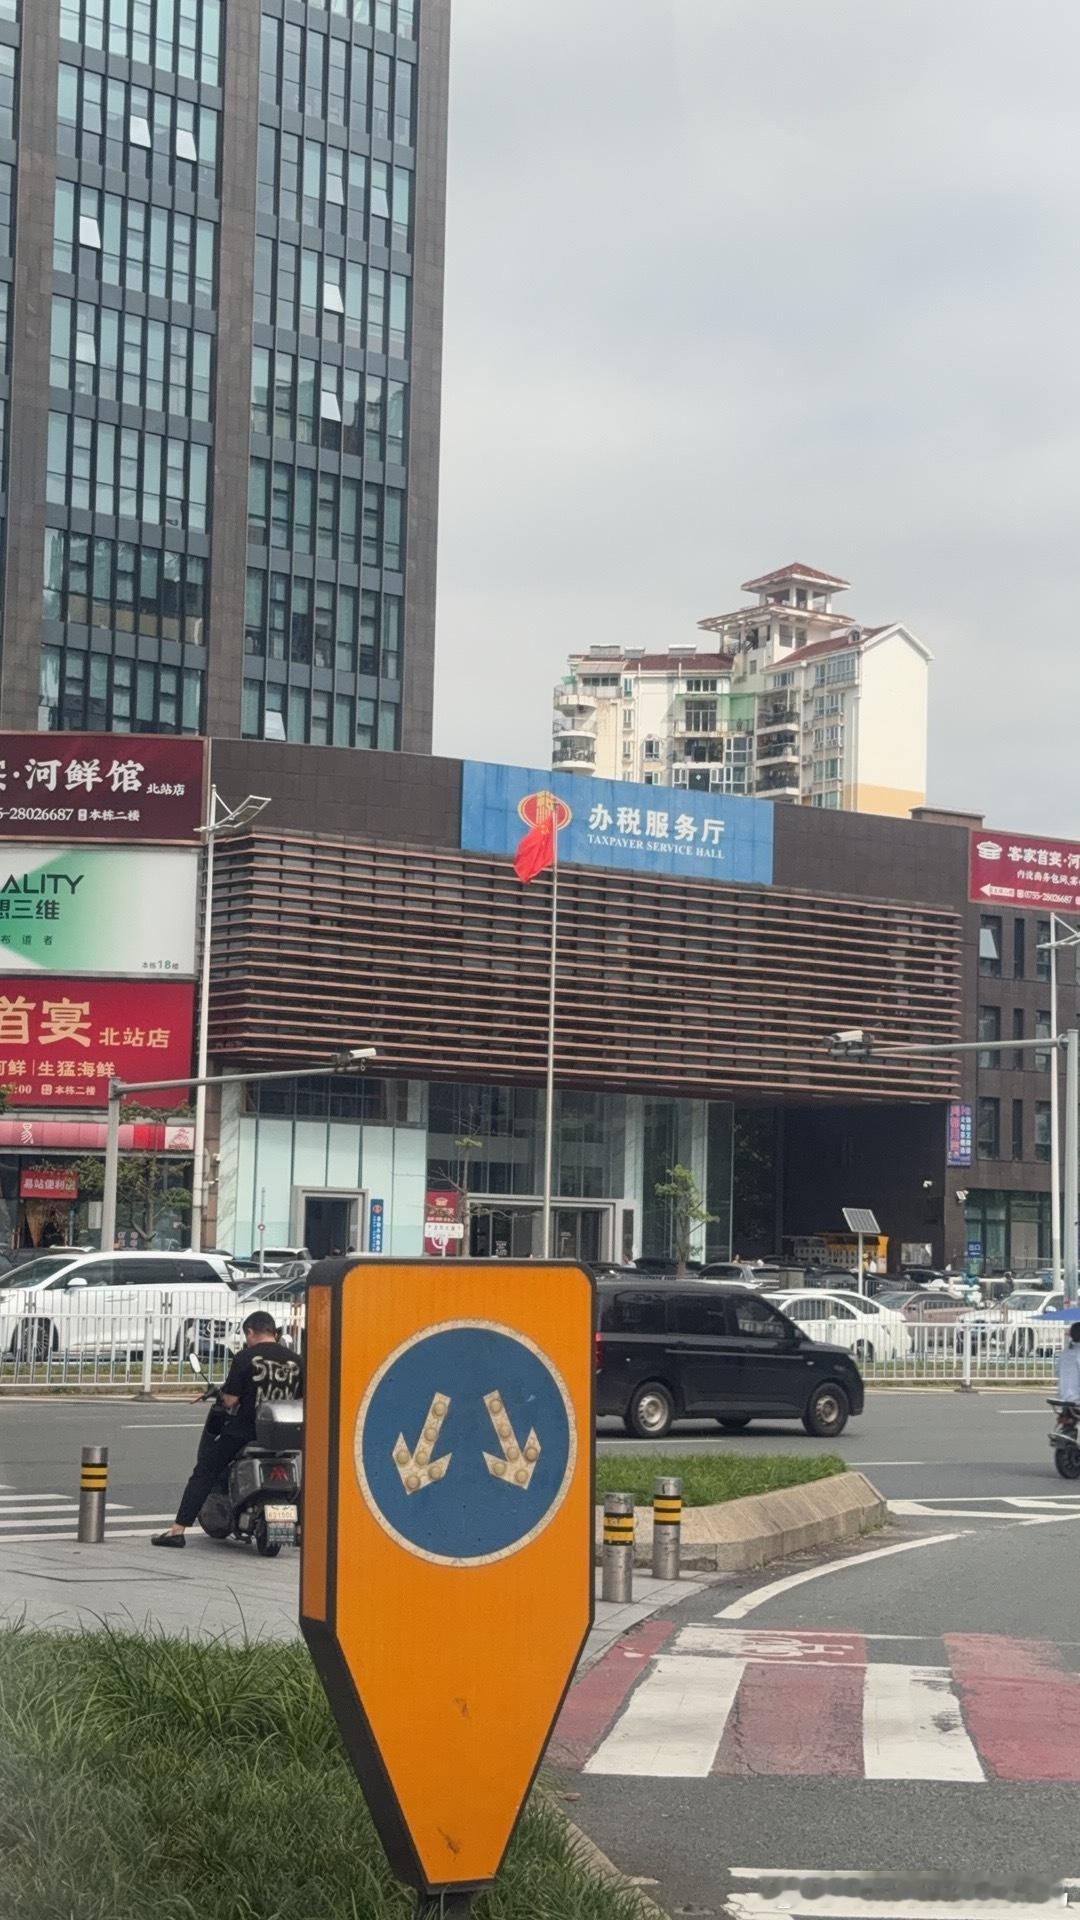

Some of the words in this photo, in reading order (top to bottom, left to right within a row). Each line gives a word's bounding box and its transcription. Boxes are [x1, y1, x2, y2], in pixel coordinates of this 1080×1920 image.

[0, 758, 145, 792] ·河鲜馆
[146, 784, 185, 796] 北站店
[588, 803, 725, 845] 办税服务厅
[587, 833, 644, 850] TAXPAYER
[647, 840, 693, 856] SERVICE
[696, 846, 725, 860] HALL
[1, 874, 84, 894] ALITY
[98, 1027, 170, 1048] 北站店
[38, 1060, 116, 1078] 生猛海鲜
[252, 1356, 299, 1384] STOP
[255, 1382, 299, 1408] NOW
